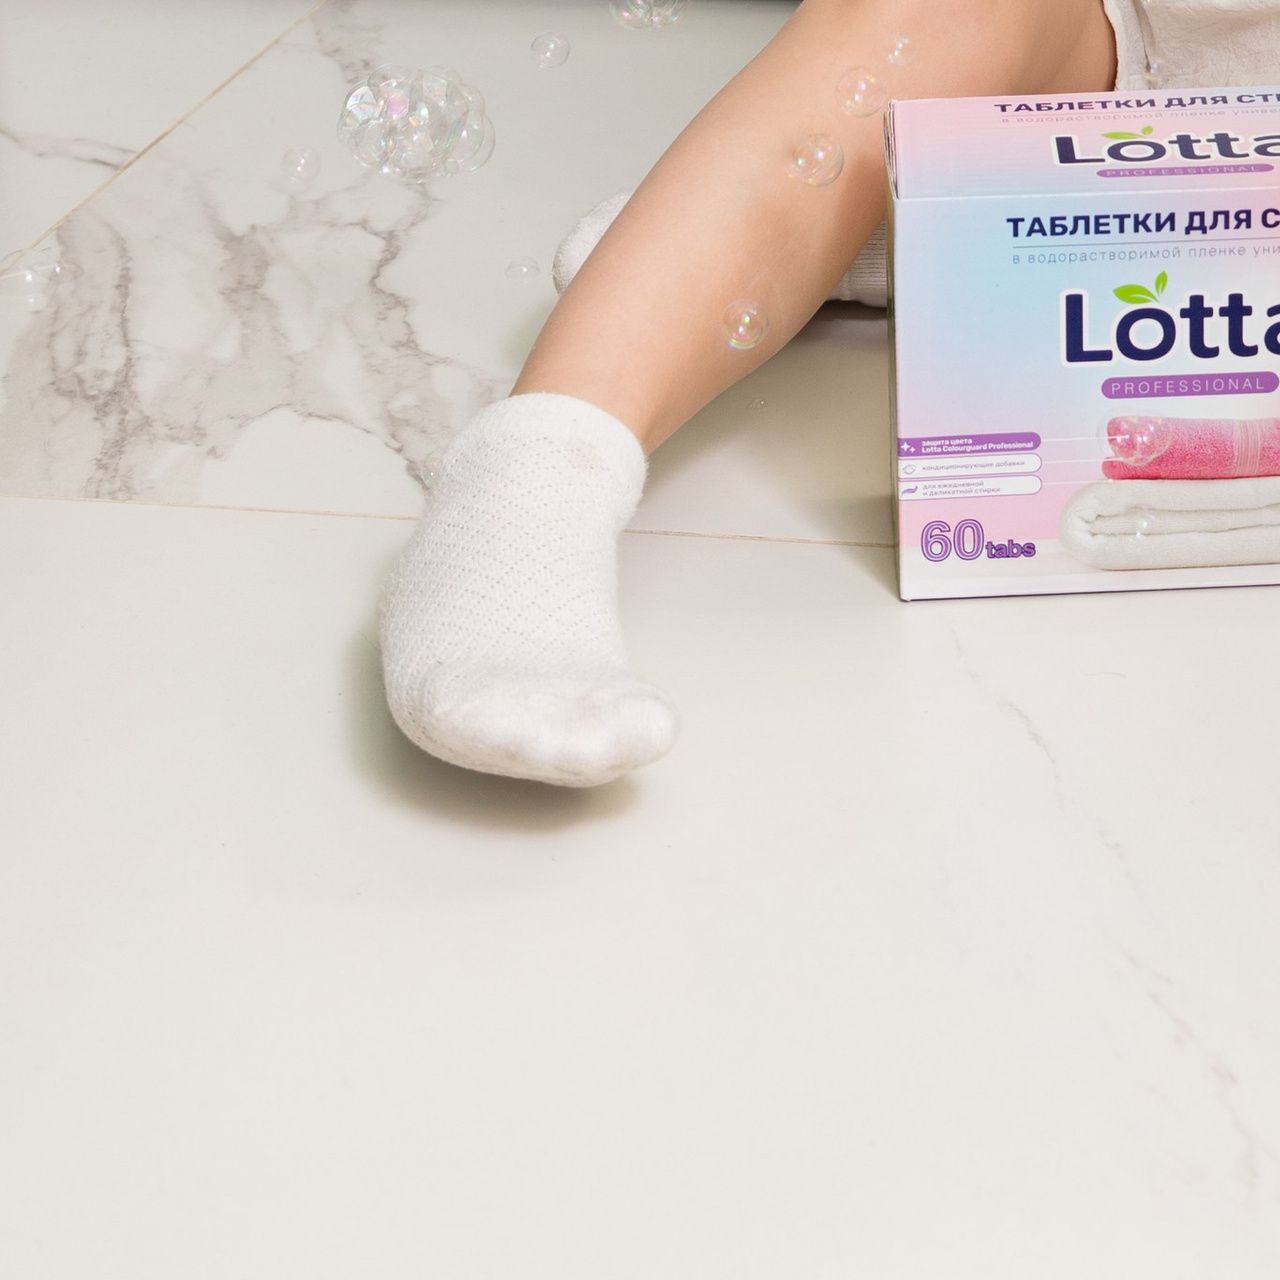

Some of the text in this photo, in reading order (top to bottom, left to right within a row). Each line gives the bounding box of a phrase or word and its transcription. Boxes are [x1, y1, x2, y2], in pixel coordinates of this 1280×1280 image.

[994, 98, 1155, 113] ТАБЛЕТКИ
[1165, 95, 1230, 108] ДЛЯ
[1106, 165, 1259, 178] PROFESSIONAL
[1006, 212, 1177, 238] ТАБЛЕТКИ
[1184, 209, 1253, 235] ДЛЯ
[1012, 255, 1021, 264] в
[1028, 246, 1182, 265] водорастворимой
[1188, 246, 1246, 258] пленке
[1111, 378, 1265, 394] PROFESSIONAL
[943, 443, 987, 453] Colourguard
[988, 441, 1033, 450] Professional
[921, 519, 1036, 562] 60 tabs
